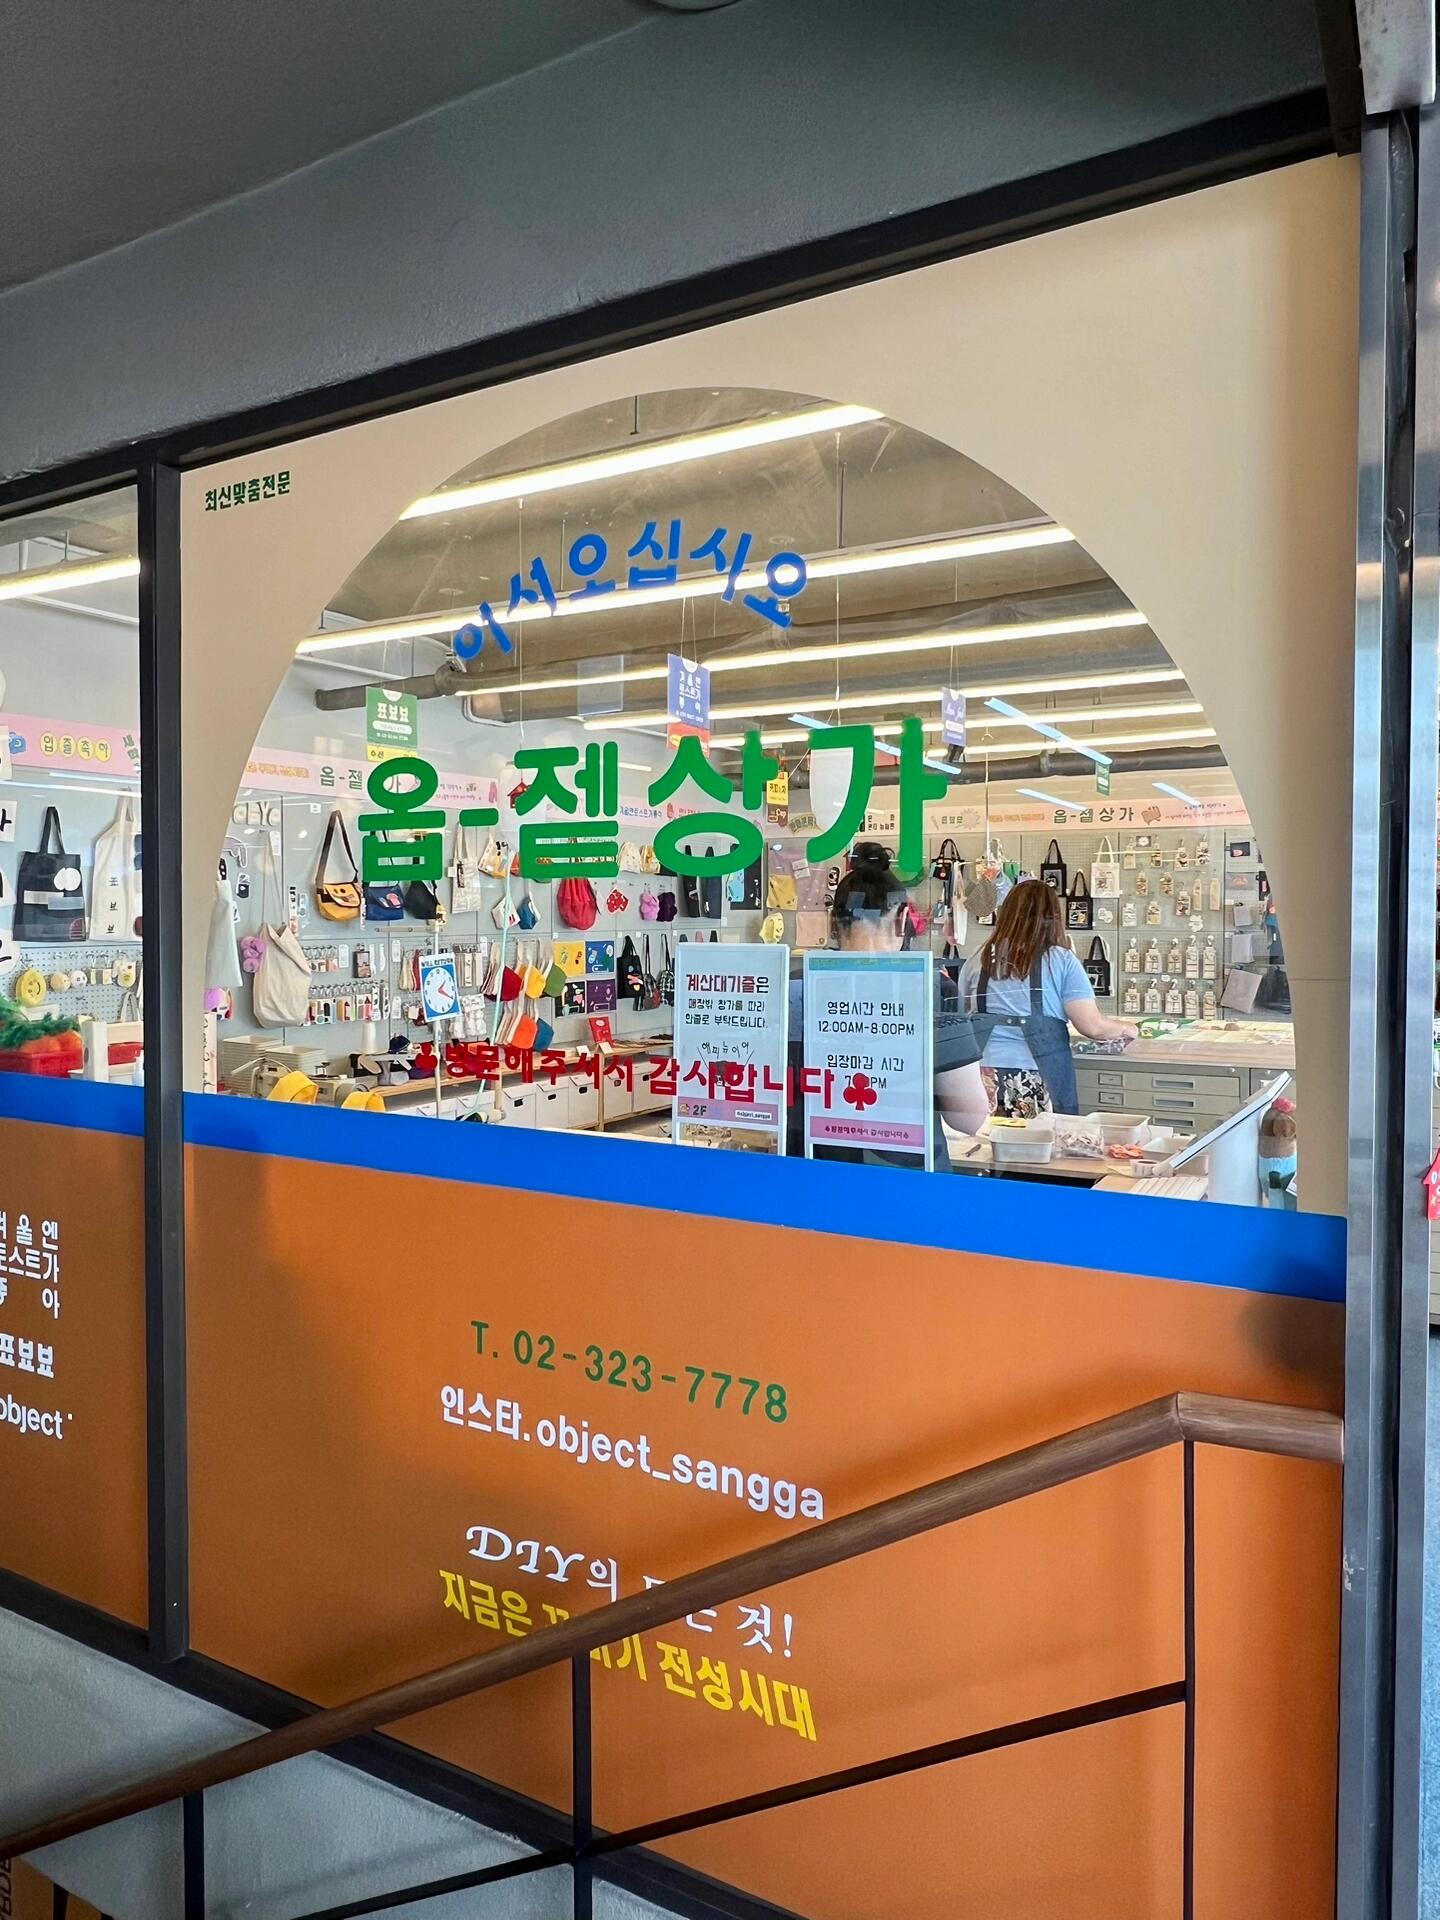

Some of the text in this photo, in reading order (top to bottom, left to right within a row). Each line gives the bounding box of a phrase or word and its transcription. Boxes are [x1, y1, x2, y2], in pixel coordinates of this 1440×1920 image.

[205, 471, 290, 511] 최신맞춤전문
[686, 974, 769, 994] 계산대기줄은
[718, 999, 744, 1011] 창가를
[827, 1001, 904, 1017] 영업시간 안내
[685, 1013, 769, 1029] 한줄로 부탁드립니다.
[818, 1020, 915, 1036] 12:00AM-8:00PM
[827, 1054, 905, 1072] 입장마감 시간
[648, 1055, 835, 1110] 감사합니다
[692, 1104, 707, 1116] 2F
[470, 1320, 787, 1424] T. 02-323-7778
[440, 1385, 824, 1520] 인스타.object_sangga
[465, 1525, 617, 1603] DIY의
[736, 1603, 793, 1658] 것!
[439, 1569, 533, 1638] 지금은
[655, 1640, 818, 1743] 전성시대
